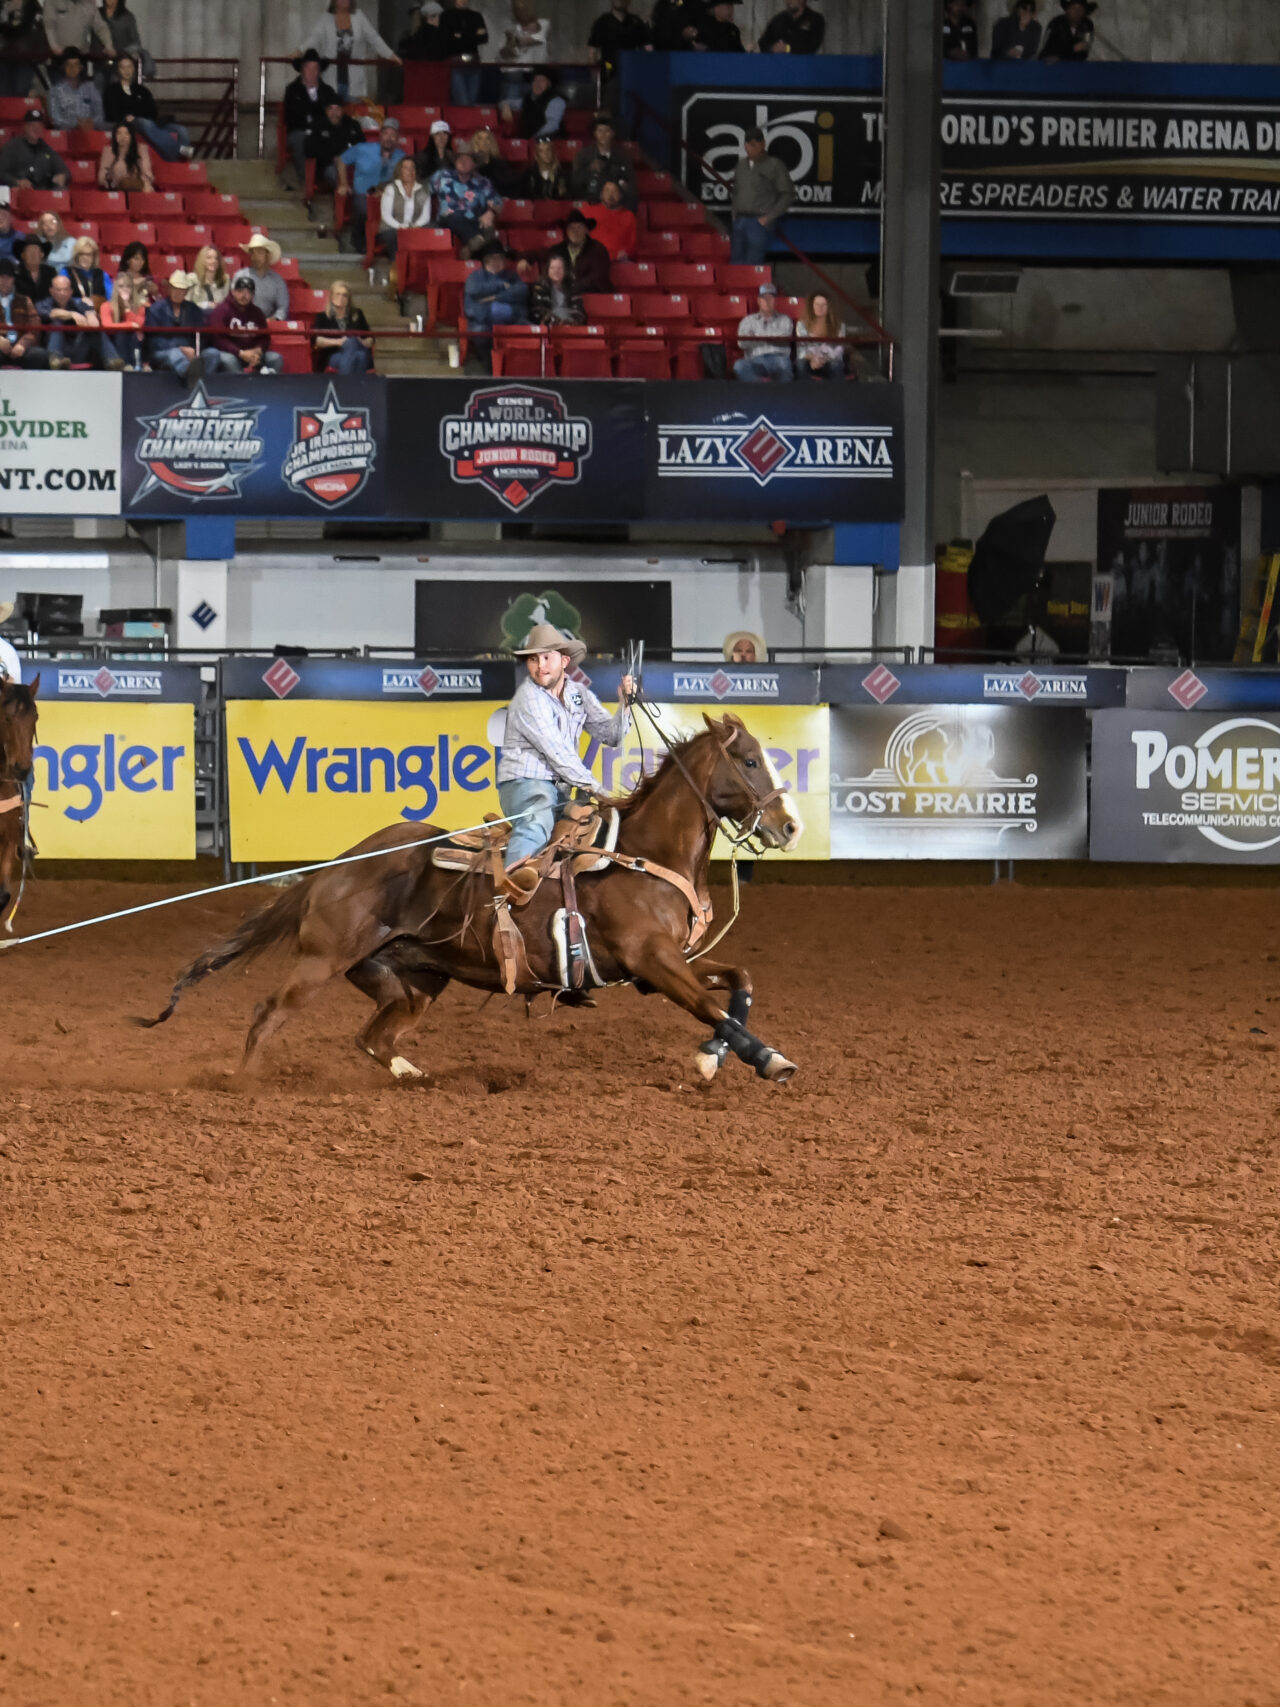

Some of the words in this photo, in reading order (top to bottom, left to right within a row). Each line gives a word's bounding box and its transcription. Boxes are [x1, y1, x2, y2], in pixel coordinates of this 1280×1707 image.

[941, 114, 1034, 146] ORLD'S
[1042, 117, 1157, 148] PREMIER
[1163, 119, 1250, 150] ARENA
[970, 183, 1108, 208] SPREADERS
[1117, 186, 1133, 208] &
[1143, 187, 1222, 210] WATER
[497, 397, 533, 406] CINCH
[488, 406, 545, 421] WORLD
[156, 419, 204, 439] TIMED
[203, 419, 254, 439] EVENT
[445, 421, 586, 452] CHAMPIONSHIP
[140, 439, 261, 459] CHAMPIONSHIP
[309, 429, 366, 450] IRONMAN
[285, 442, 372, 476] CHAMPIONSHIP
[477, 449, 517, 464] JUNIOR
[520, 449, 556, 464] RODEO
[658, 437, 733, 464] LAZY
[794, 438, 893, 465] ARENA
[1124, 503, 1168, 526] JUNIOR
[1171, 503, 1212, 526] RODEO
[59, 675, 90, 688] LAZY
[118, 676, 162, 689] ARENA
[383, 675, 414, 687] LAZY
[442, 675, 481, 687] ARENA
[674, 678, 706, 690] LAZY
[734, 679, 778, 691] ARENA
[984, 679, 1016, 692] LAZY
[1044, 680, 1087, 693] ARENA
[33, 734, 185, 821] ngler
[237, 735, 501, 820] Wrangle
[830, 791, 906, 813] LOST
[914, 792, 1037, 814] PRAIRIE
[1181, 792, 1280, 812] SERVIC
[1142, 812, 1266, 827] TELECOMMUNICATIONS
